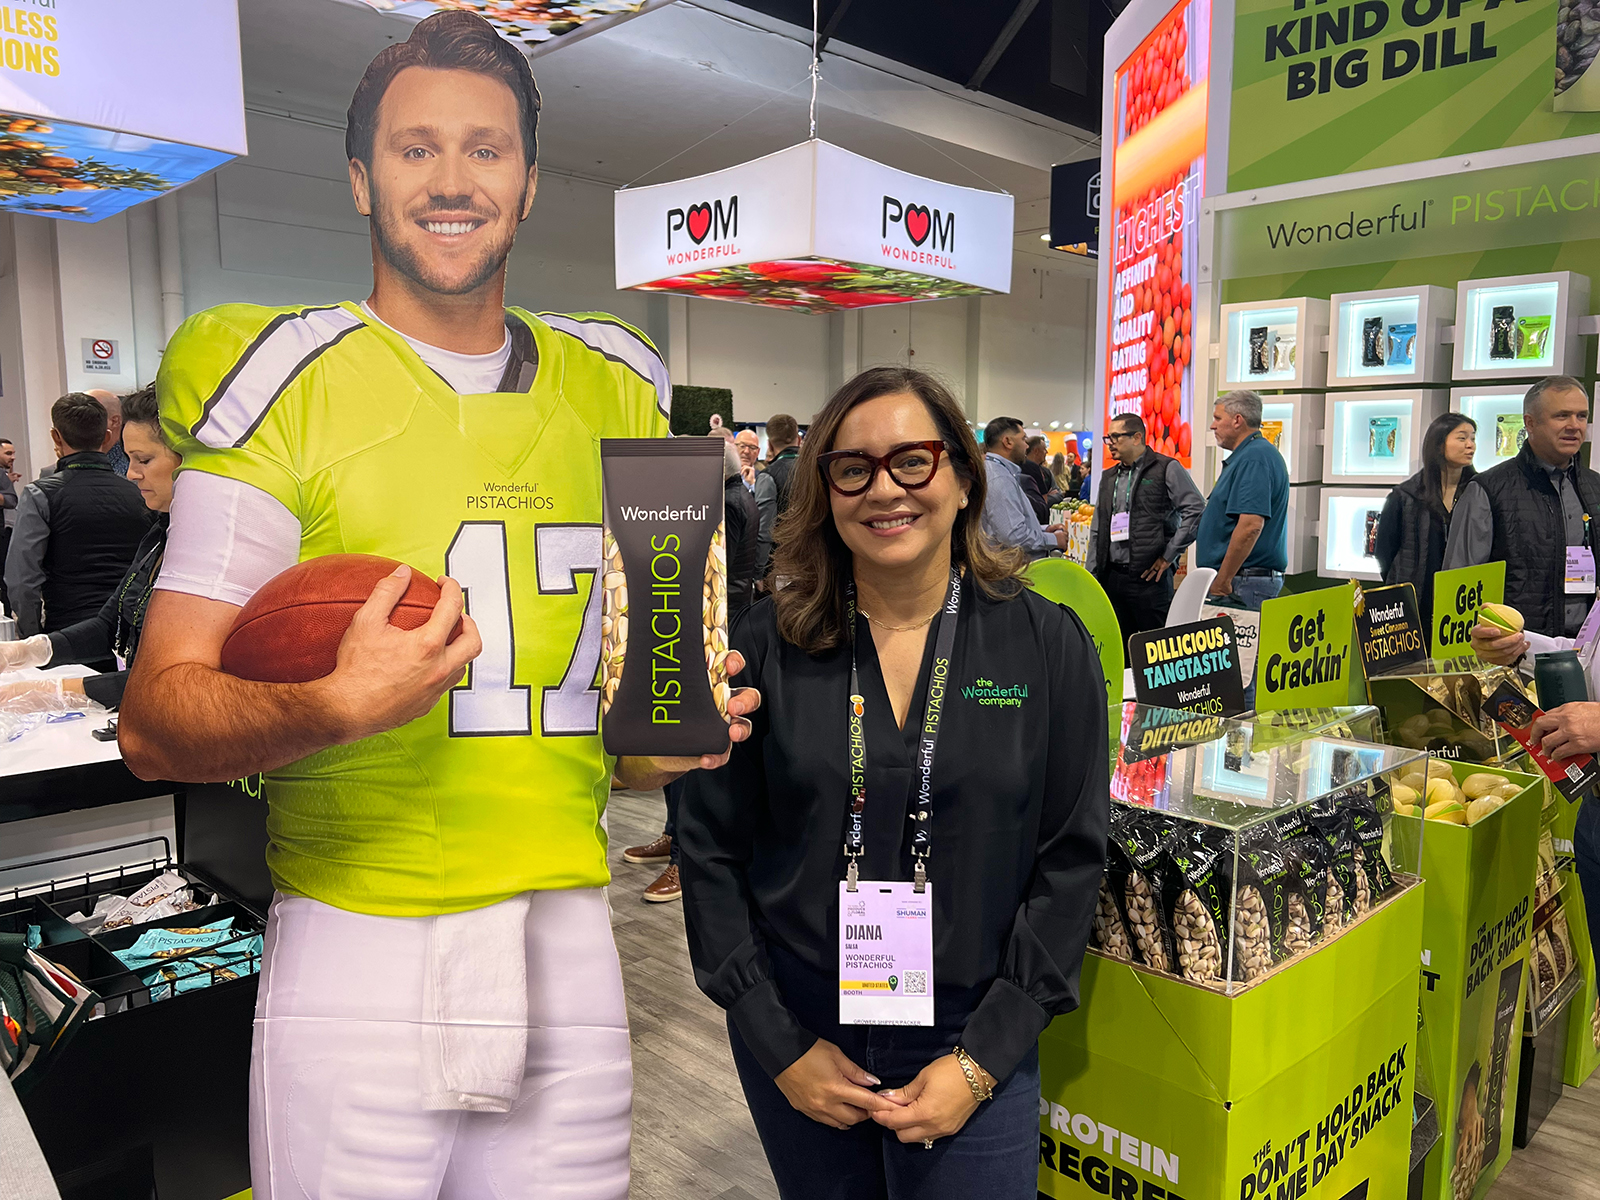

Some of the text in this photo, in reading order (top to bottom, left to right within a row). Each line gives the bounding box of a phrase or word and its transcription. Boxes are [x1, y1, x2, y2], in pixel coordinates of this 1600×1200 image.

[0, 6, 58, 42] LESS
[1265, 0, 1389, 62] KIND
[1287, 21, 1497, 101] BIG DILL
[667, 195, 738, 250] POM
[882, 195, 955, 253] POM
[1115, 172, 1200, 265] HIGHEST
[1267, 200, 1428, 249] Wonderful
[667, 244, 738, 266] WONDERFUL
[881, 244, 954, 269] WONDERFUL
[1114, 254, 1157, 295] AFFINITY
[1113, 293, 1134, 320] AND
[1113, 310, 1155, 345] QUALITY
[1111, 340, 1147, 371] RATING
[1111, 369, 1147, 396] AMONG
[466, 496, 554, 510] PISTACHIOS
[484, 482, 537, 493] Wonderful
[620, 505, 707, 522] Wonderful
[1369, 601, 1405, 624] Wonderful
[1456, 580, 1484, 615] Get
[445, 520, 603, 738] 17
[650, 533, 682, 724] PISTACHIOS
[1145, 627, 1224, 665] DILLICIOUS
[1288, 609, 1325, 653] Get
[1364, 629, 1420, 662] PISTACHIOS
[976, 677, 993, 687] the
[1144, 648, 1232, 690] TANGTASTIC
[1265, 643, 1348, 693] Crackin'
[961, 684, 1028, 699] Wonderful
[979, 698, 1022, 708] company
[1177, 683, 1211, 703] Wonderful
[919, 657, 949, 804] Wonderful PISTACHIOS
[851, 716, 864, 795] PISTACHIOS
[158, 936, 215, 945] PISTACHIOS
[846, 925, 882, 940] DIANA
[1470, 920, 1503, 967] DON'T
[1504, 895, 1528, 937] HOLD
[1477, 922, 1487, 939] THE
[846, 954, 896, 962] WONDERFUL
[1466, 950, 1495, 999] BACK
[1497, 920, 1528, 965] SNACK
[1240, 1042, 1407, 1200] DON'T HOLD BACK
[1312, 1126, 1349, 1188] DAY
[1350, 1076, 1403, 1149] SNACK
[1253, 1139, 1271, 1168] THE
